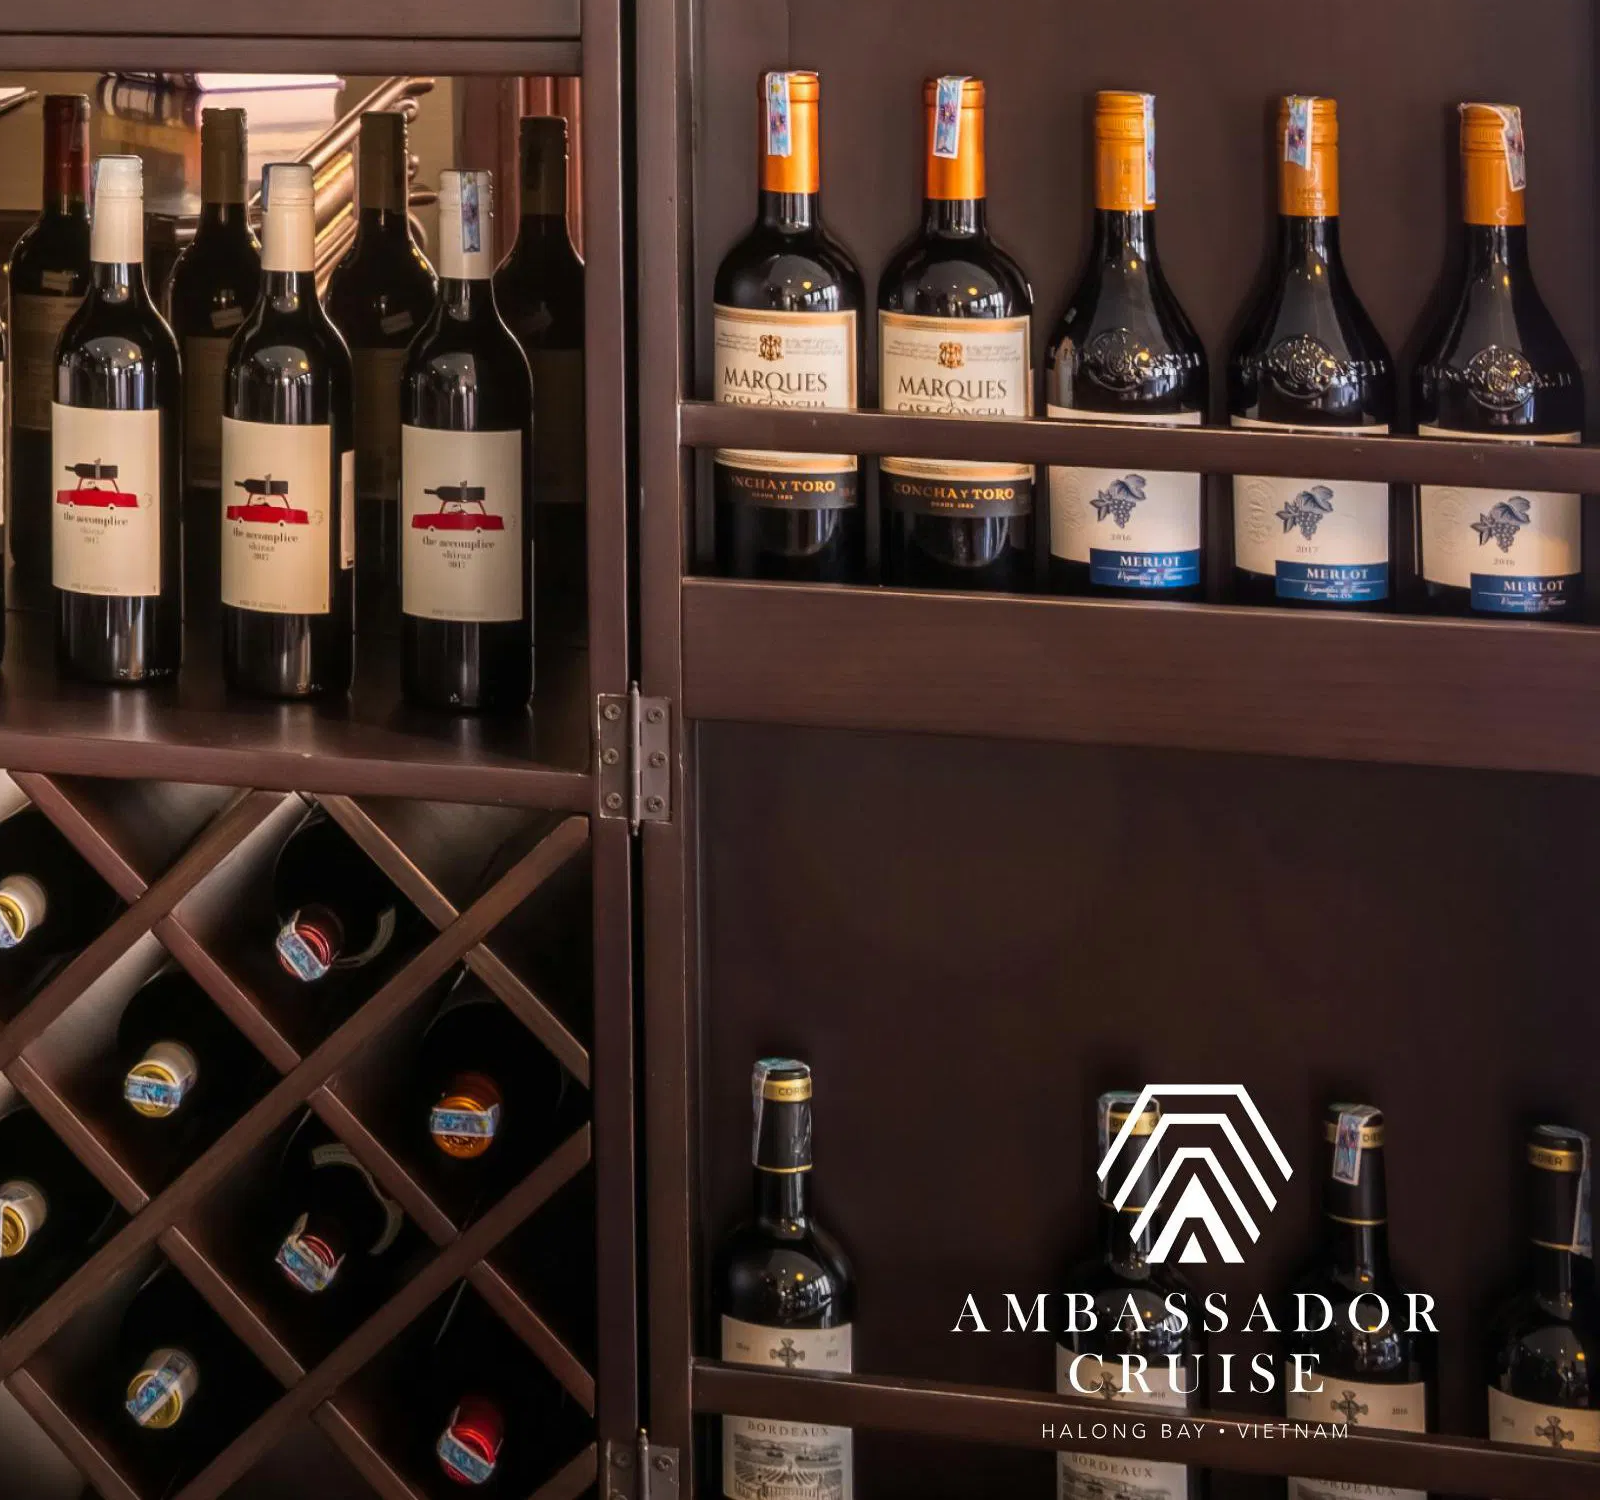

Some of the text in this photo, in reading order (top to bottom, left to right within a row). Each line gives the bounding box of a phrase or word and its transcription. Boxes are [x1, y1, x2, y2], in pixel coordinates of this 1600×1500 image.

[724, 366, 827, 393] MARQUES
[898, 375, 1007, 401] MARQUES
[780, 481, 788, 489] Y
[790, 480, 836, 492] TORO
[894, 484, 1015, 500] CONCHA Y TORO
[63, 512, 128, 527] the accomplice
[233, 527, 298, 544] the accomplice
[249, 542, 275, 552] shiraz
[422, 536, 495, 551] the accomplice
[442, 550, 472, 559] shiraz
[1120, 556, 1181, 567] MERLOT
[1307, 568, 1368, 579] MERLOT
[1503, 580, 1564, 591] MERLOT
[747, 1420, 829, 1437] BORDEAUX
[1071, 1454, 1153, 1478] BORDEAUX
